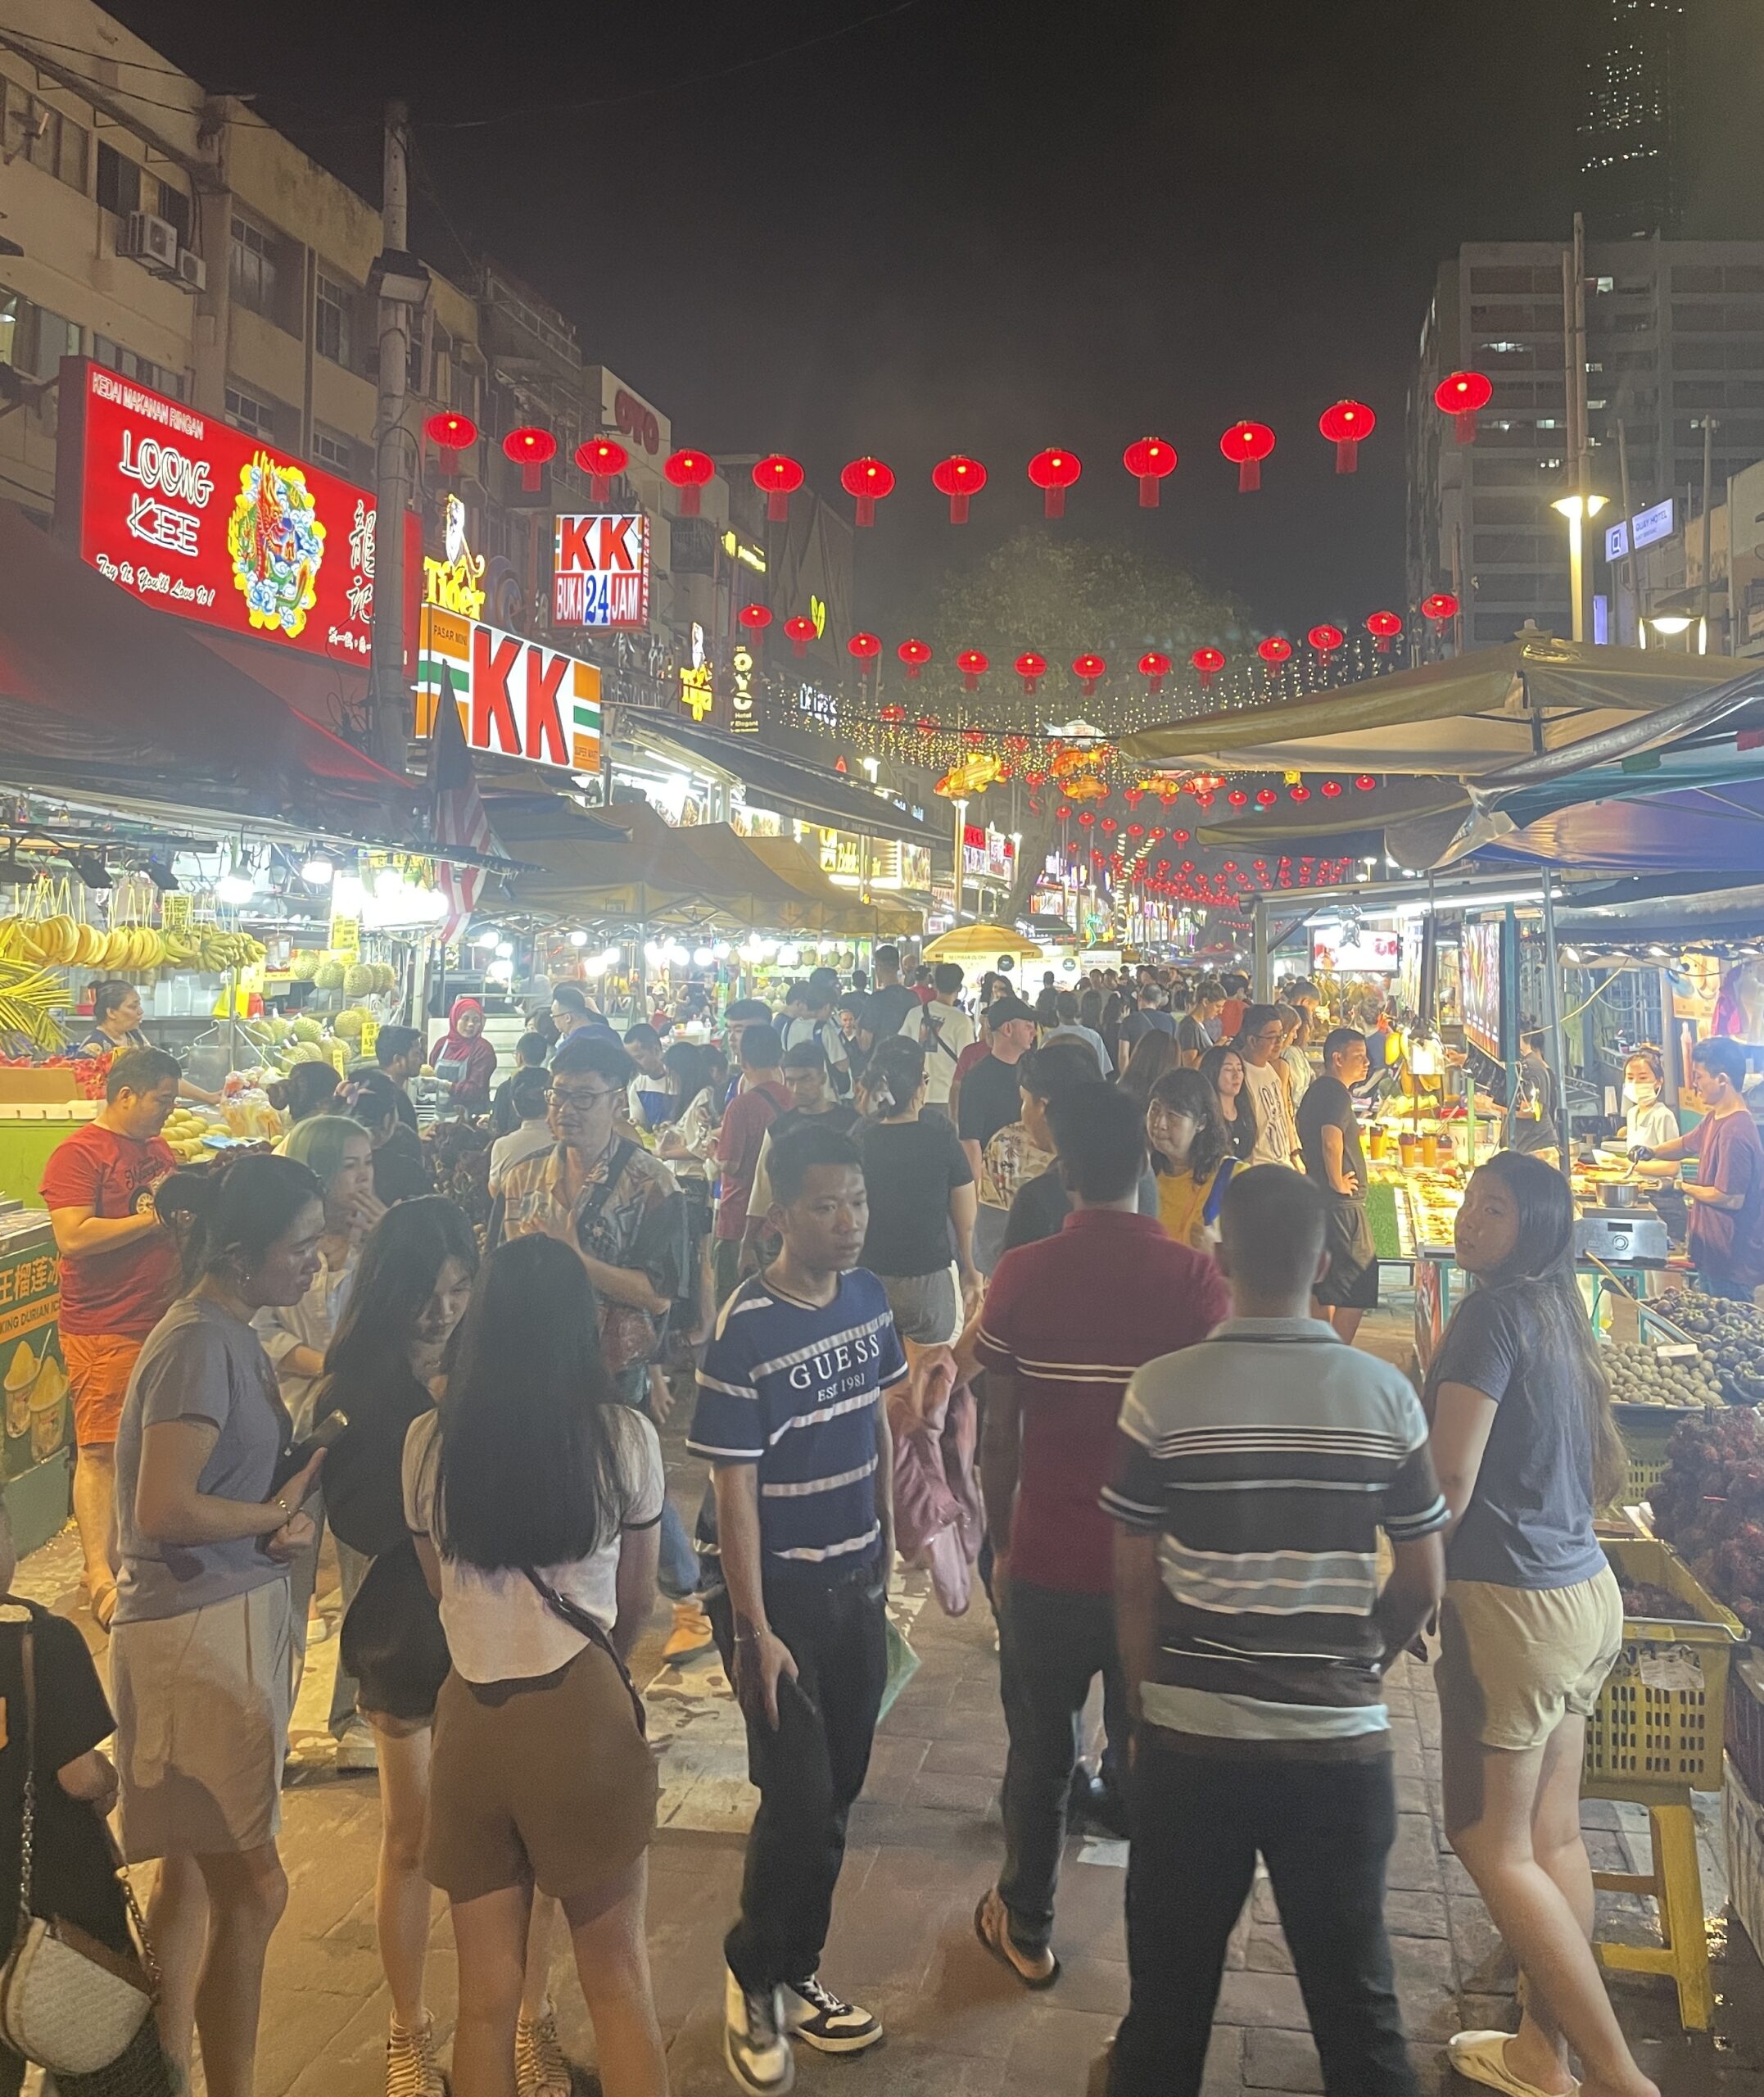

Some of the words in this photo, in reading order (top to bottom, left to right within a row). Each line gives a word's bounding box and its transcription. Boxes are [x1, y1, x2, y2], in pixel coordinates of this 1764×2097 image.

[93, 372, 122, 405] KEDAI
[123, 386, 169, 425] MAKANAN
[170, 407, 204, 441] RINGAN
[119, 429, 215, 508] LOONG
[127, 492, 200, 557] KEE
[561, 516, 636, 571] KK
[97, 554, 118, 581] Try
[137, 566, 170, 592] You'll
[170, 578, 195, 601] Love
[556, 577, 582, 620] BUKA
[585, 574, 609, 623] 24
[611, 577, 639, 620] JAM
[434, 624, 455, 642] PASAR
[472, 624, 571, 766] KK
[20, 1303, 50, 1325] DURIAN
[789, 1334, 880, 1389] GUESS
[841, 1373, 866, 1393] 1981
